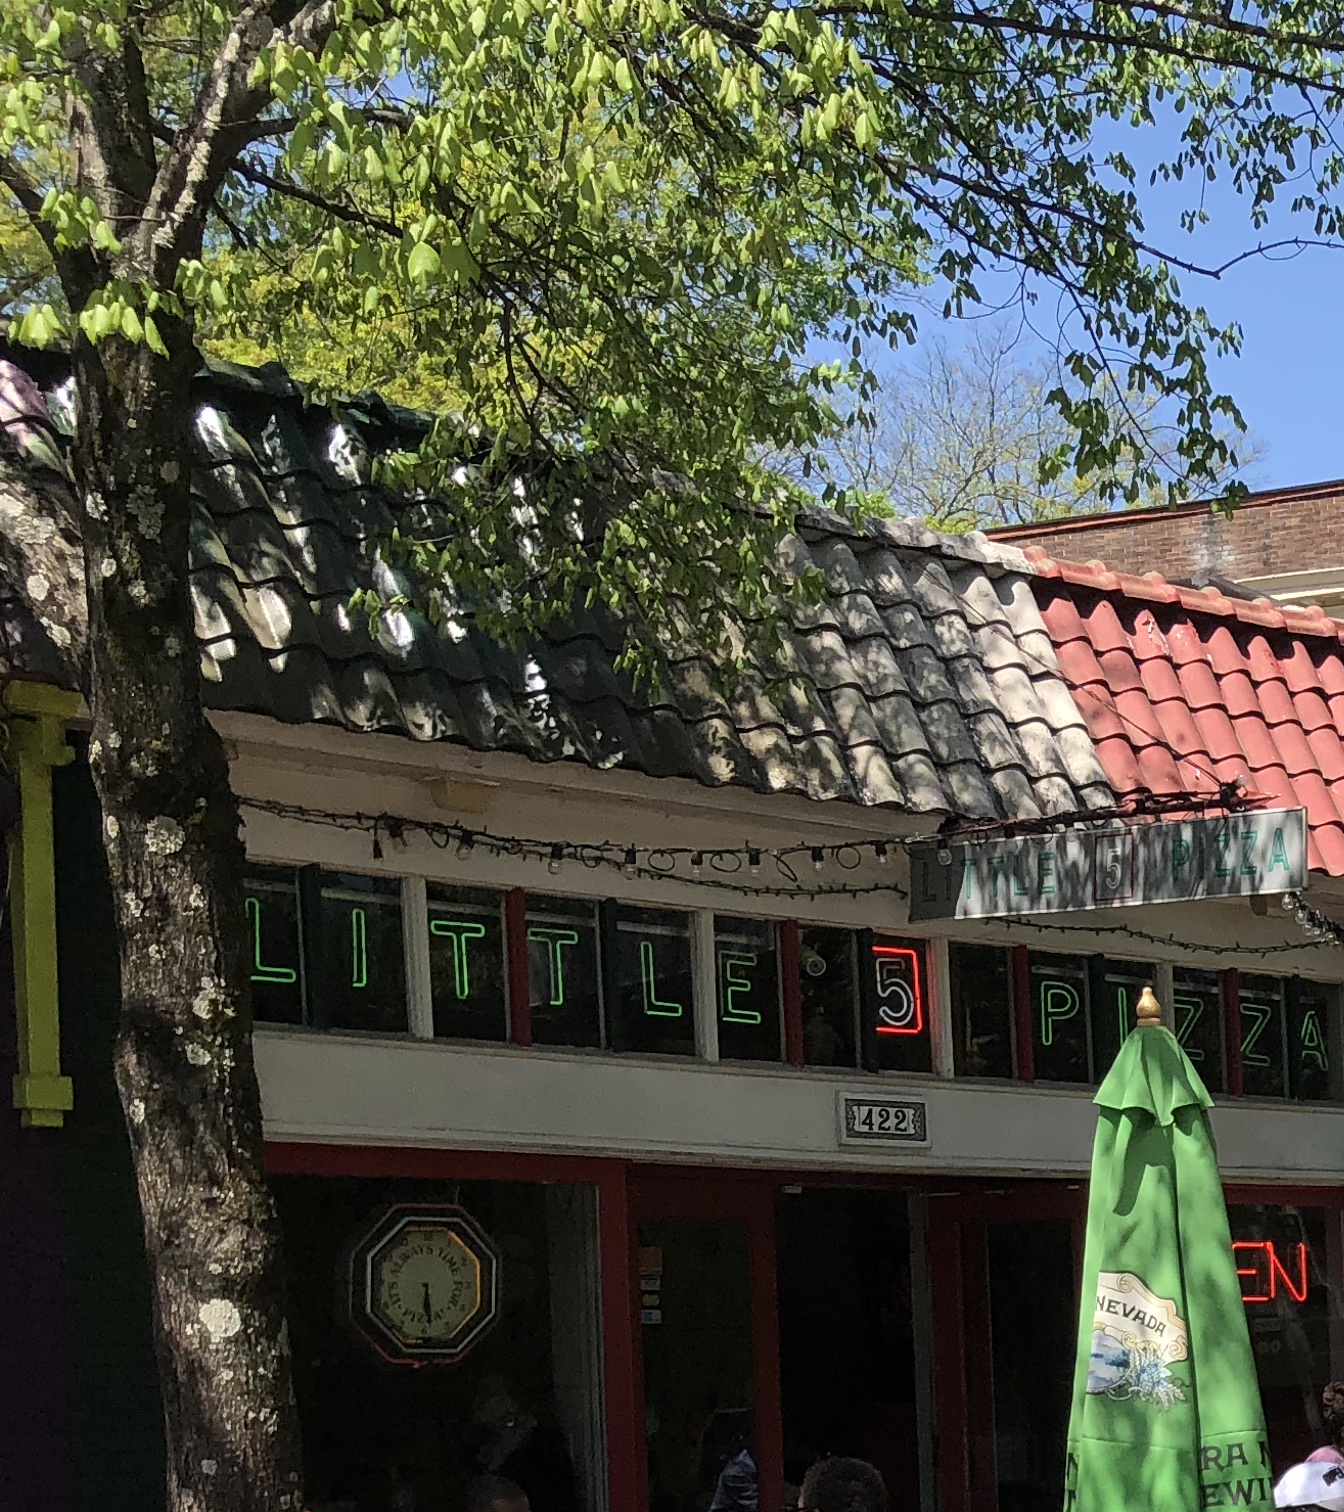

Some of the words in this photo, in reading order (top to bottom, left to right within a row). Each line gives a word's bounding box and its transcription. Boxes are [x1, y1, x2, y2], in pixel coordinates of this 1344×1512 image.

[1105, 847, 1122, 890] 5
[245, 897, 763, 1024] LITTLE
[875, 957, 915, 1027] 5
[1040, 980, 1330, 1071] PIZZA
[862, 1107, 908, 1132] 422
[1232, 1241, 1307, 1301] EN
